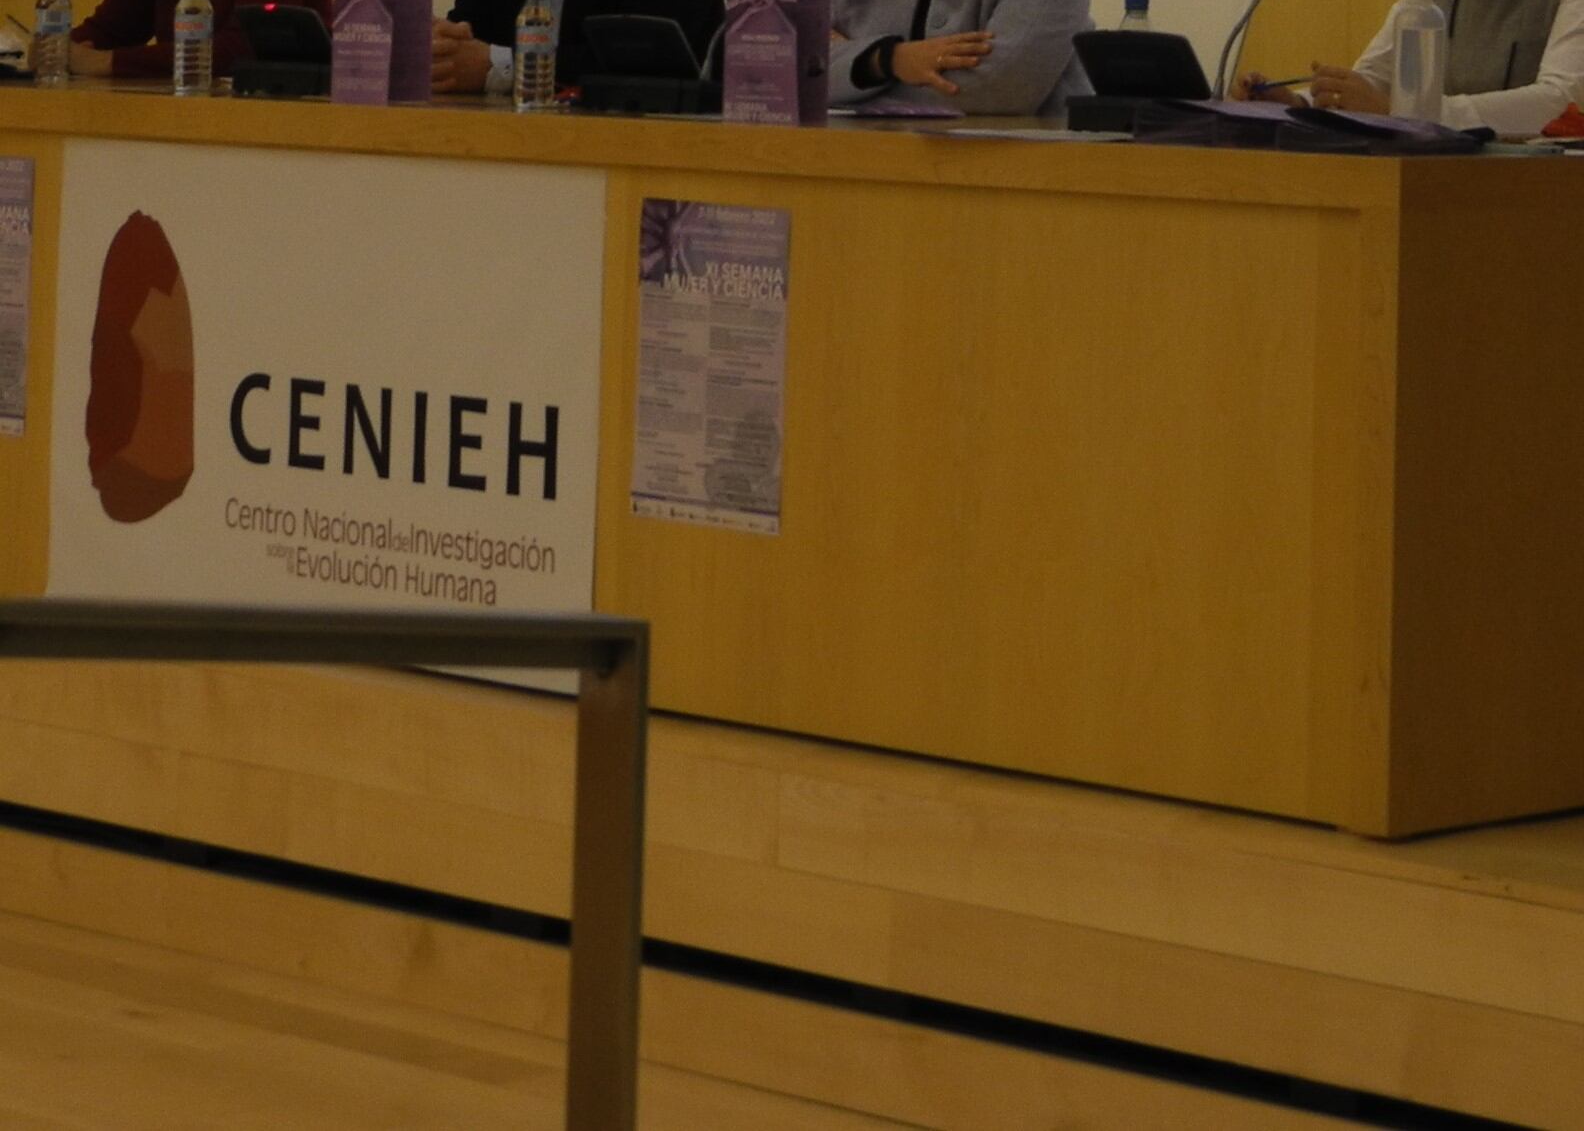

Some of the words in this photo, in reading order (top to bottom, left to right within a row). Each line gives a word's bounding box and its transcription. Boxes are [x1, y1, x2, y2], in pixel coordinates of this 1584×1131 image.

[720, 261, 784, 284] SEMANA
[229, 372, 560, 501] CENIEH
[224, 496, 297, 537] Centro
[265, 541, 295, 561] sobre
[295, 546, 397, 591] Evolución
[405, 561, 498, 606] Humana
